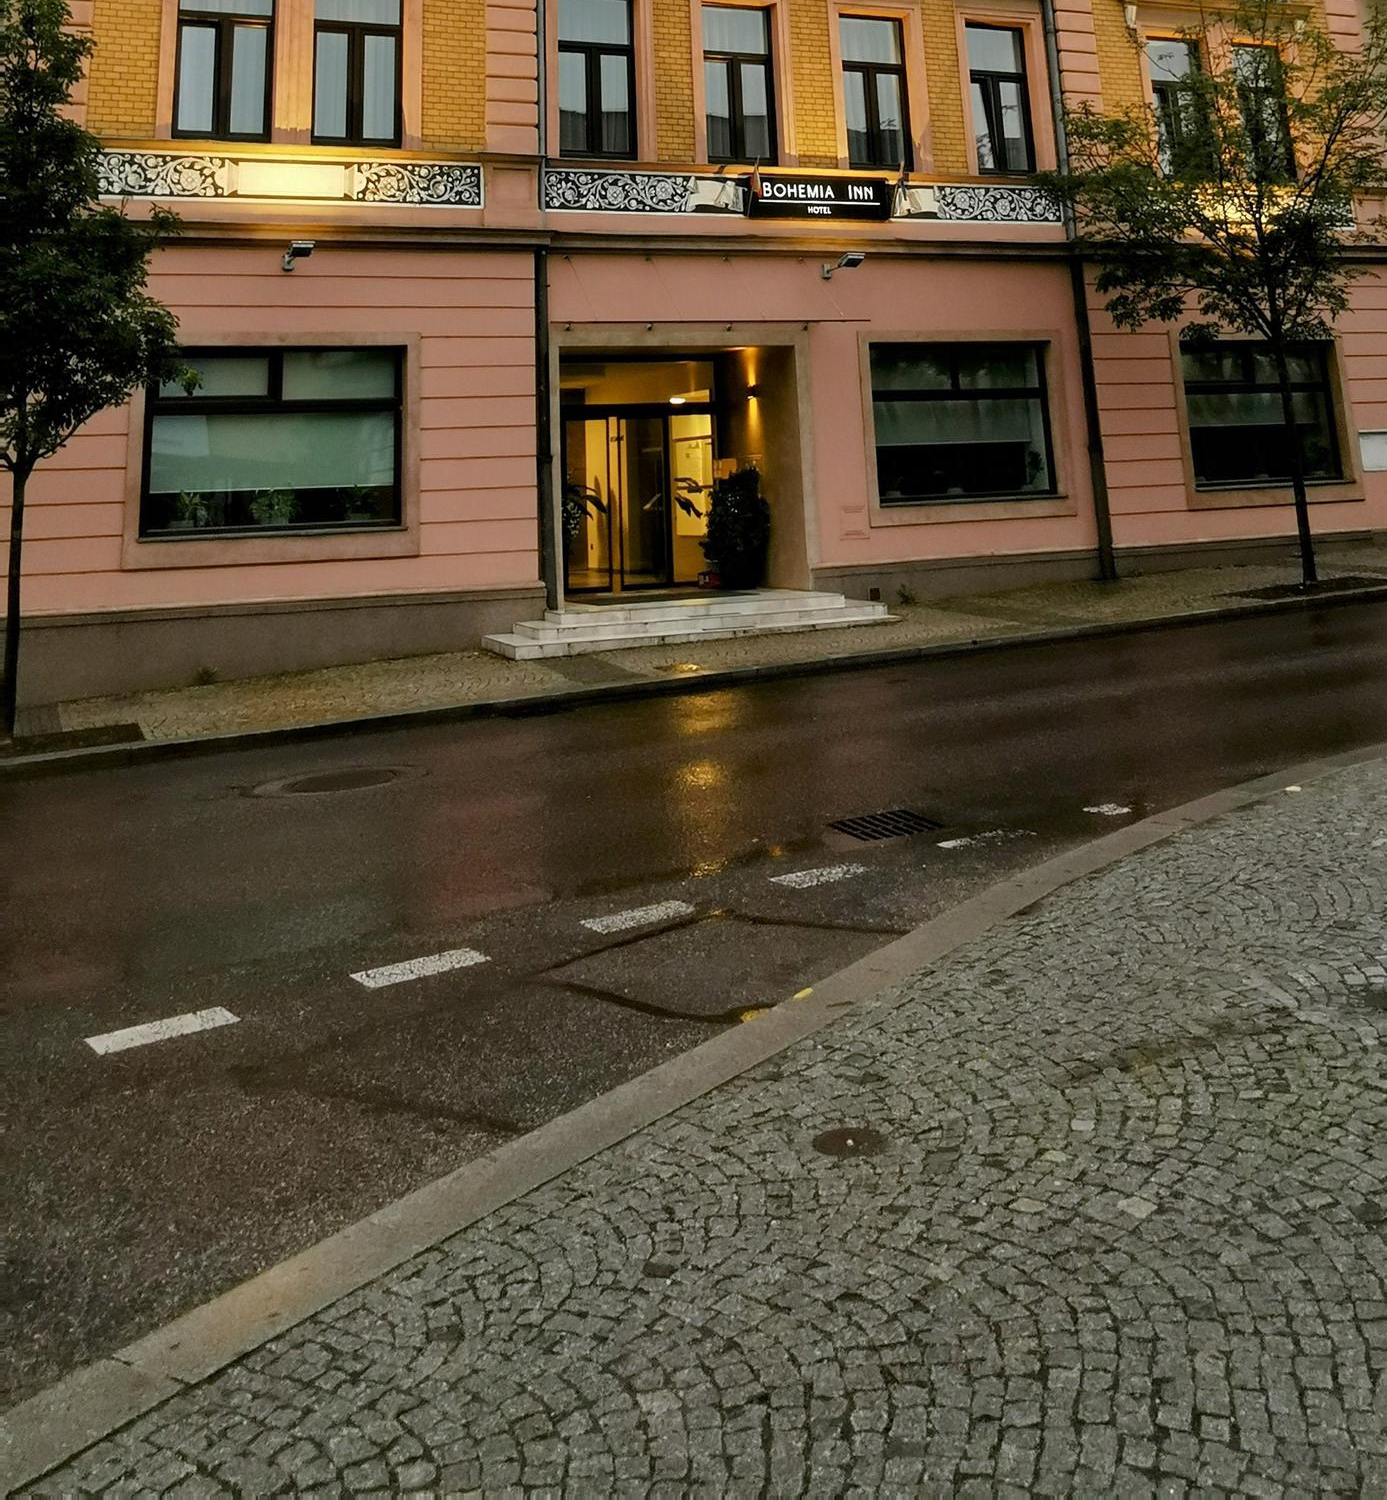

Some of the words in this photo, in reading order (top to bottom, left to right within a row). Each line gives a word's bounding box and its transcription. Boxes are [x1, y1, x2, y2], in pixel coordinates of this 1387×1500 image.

[762, 181, 835, 199] BOHEMIA
[847, 184, 874, 200] INN
[807, 206, 832, 214] HOTEL
